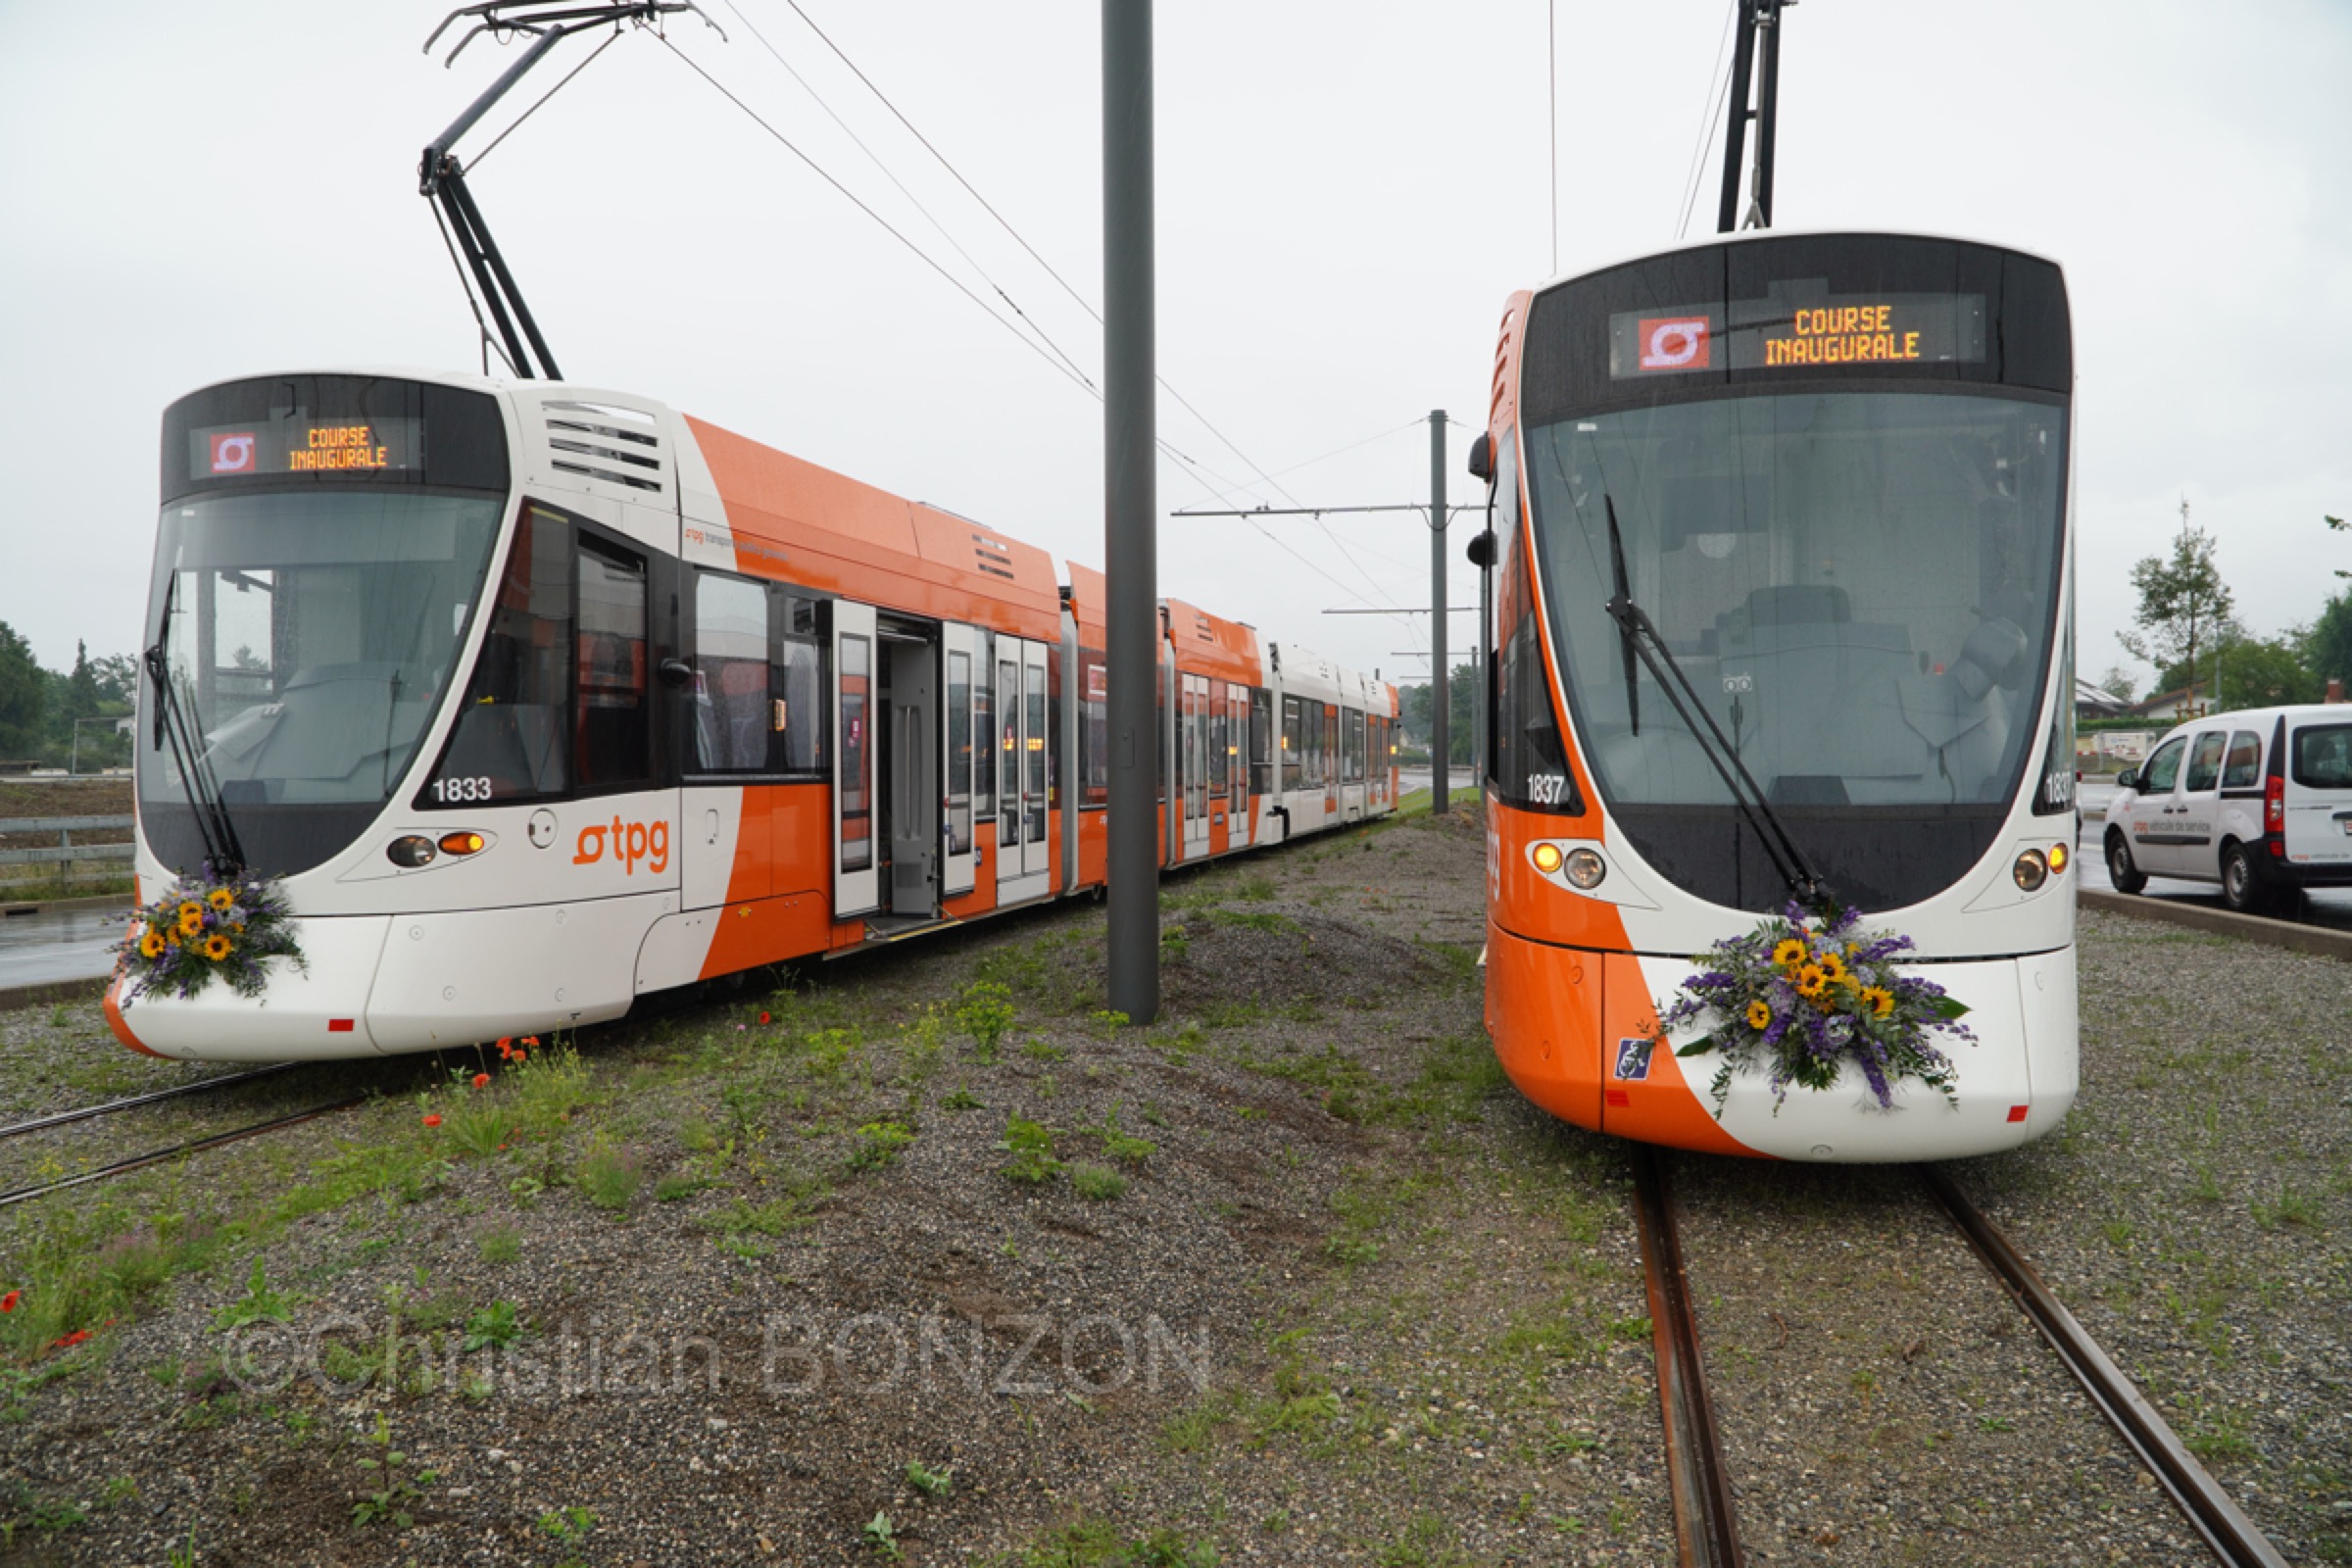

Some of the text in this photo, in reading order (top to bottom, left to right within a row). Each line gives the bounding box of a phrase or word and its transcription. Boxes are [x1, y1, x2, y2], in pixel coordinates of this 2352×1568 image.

[1795, 305, 1891, 335] COURSE
[1766, 331, 1920, 366] INAUGURALE
[309, 426, 369, 448] COURSE
[290, 446, 388, 470] INAUGURALE
[433, 776, 492, 803] 1833
[1527, 774, 1565, 804] 1837
